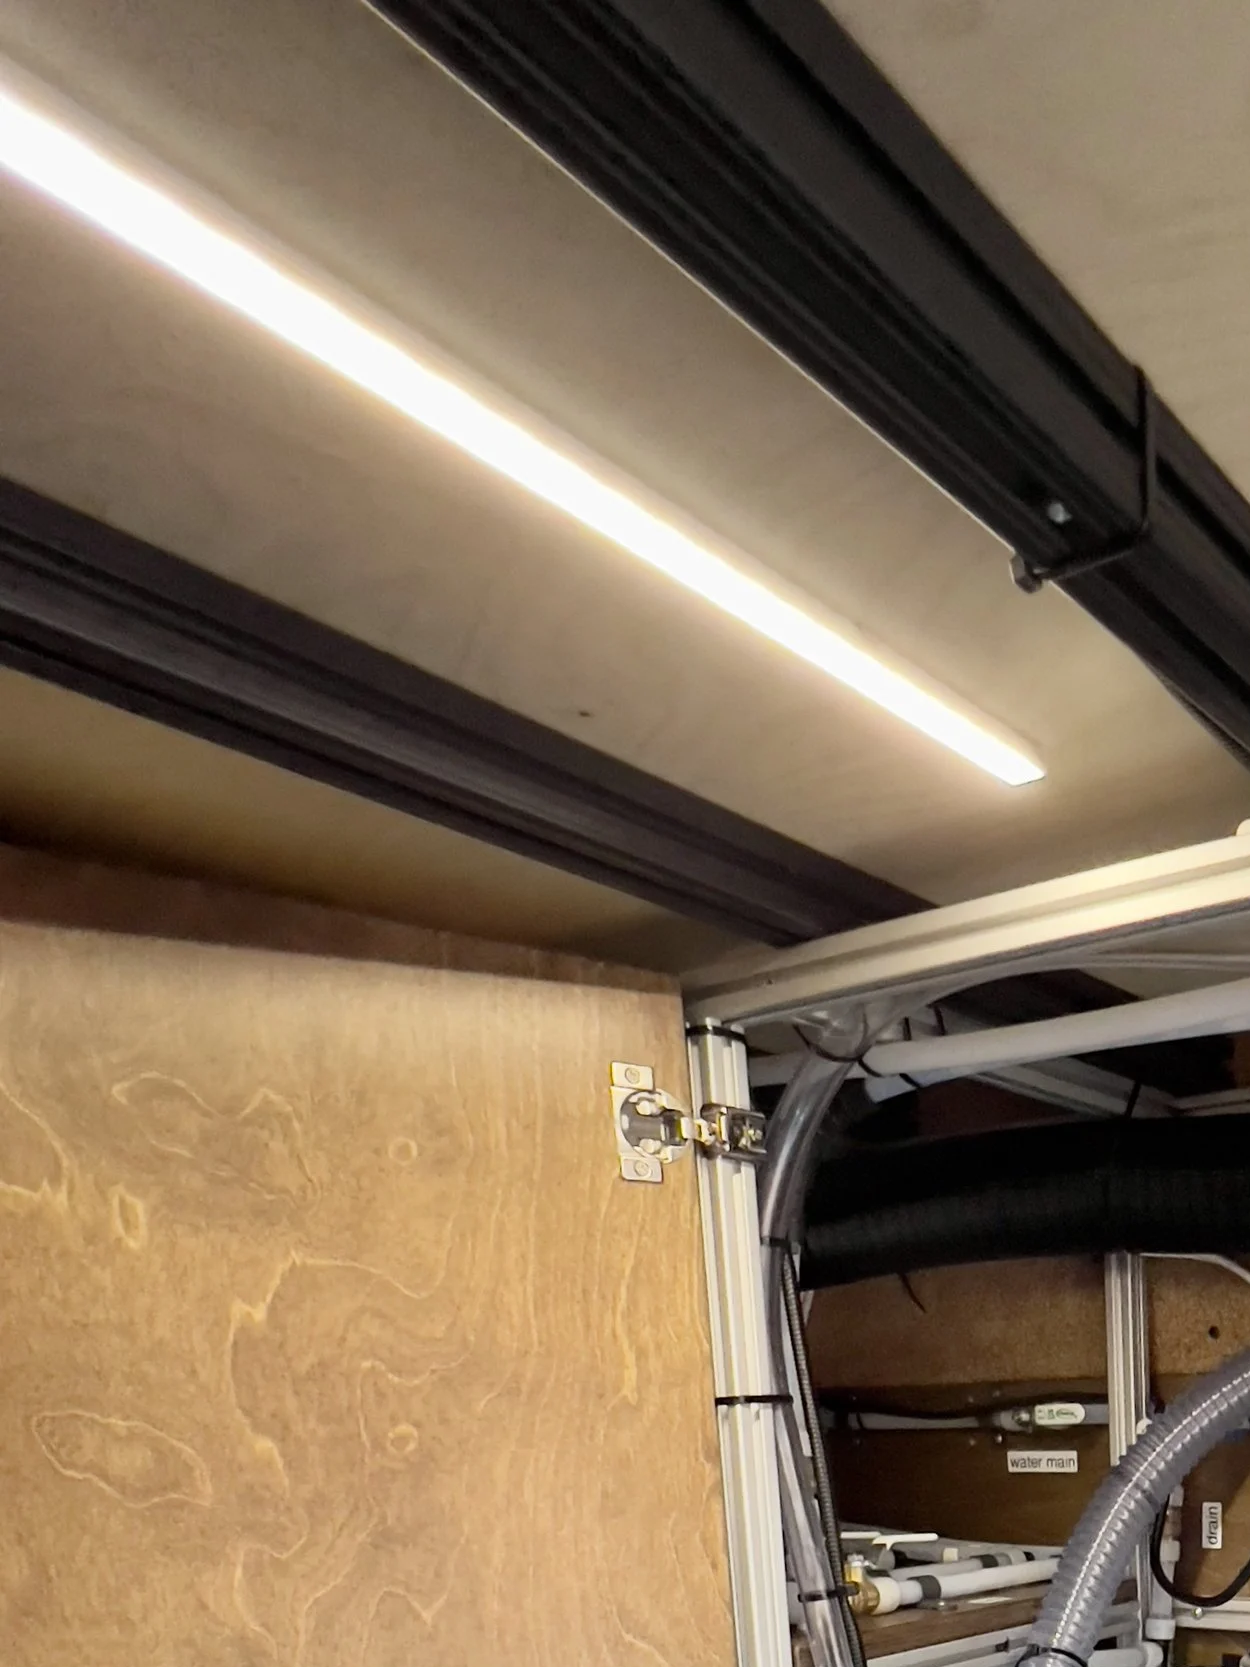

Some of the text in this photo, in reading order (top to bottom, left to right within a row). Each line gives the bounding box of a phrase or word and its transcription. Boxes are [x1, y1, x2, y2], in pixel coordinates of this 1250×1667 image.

[1010, 1457, 1076, 1469] water main
[1206, 1506, 1218, 1545] drain
